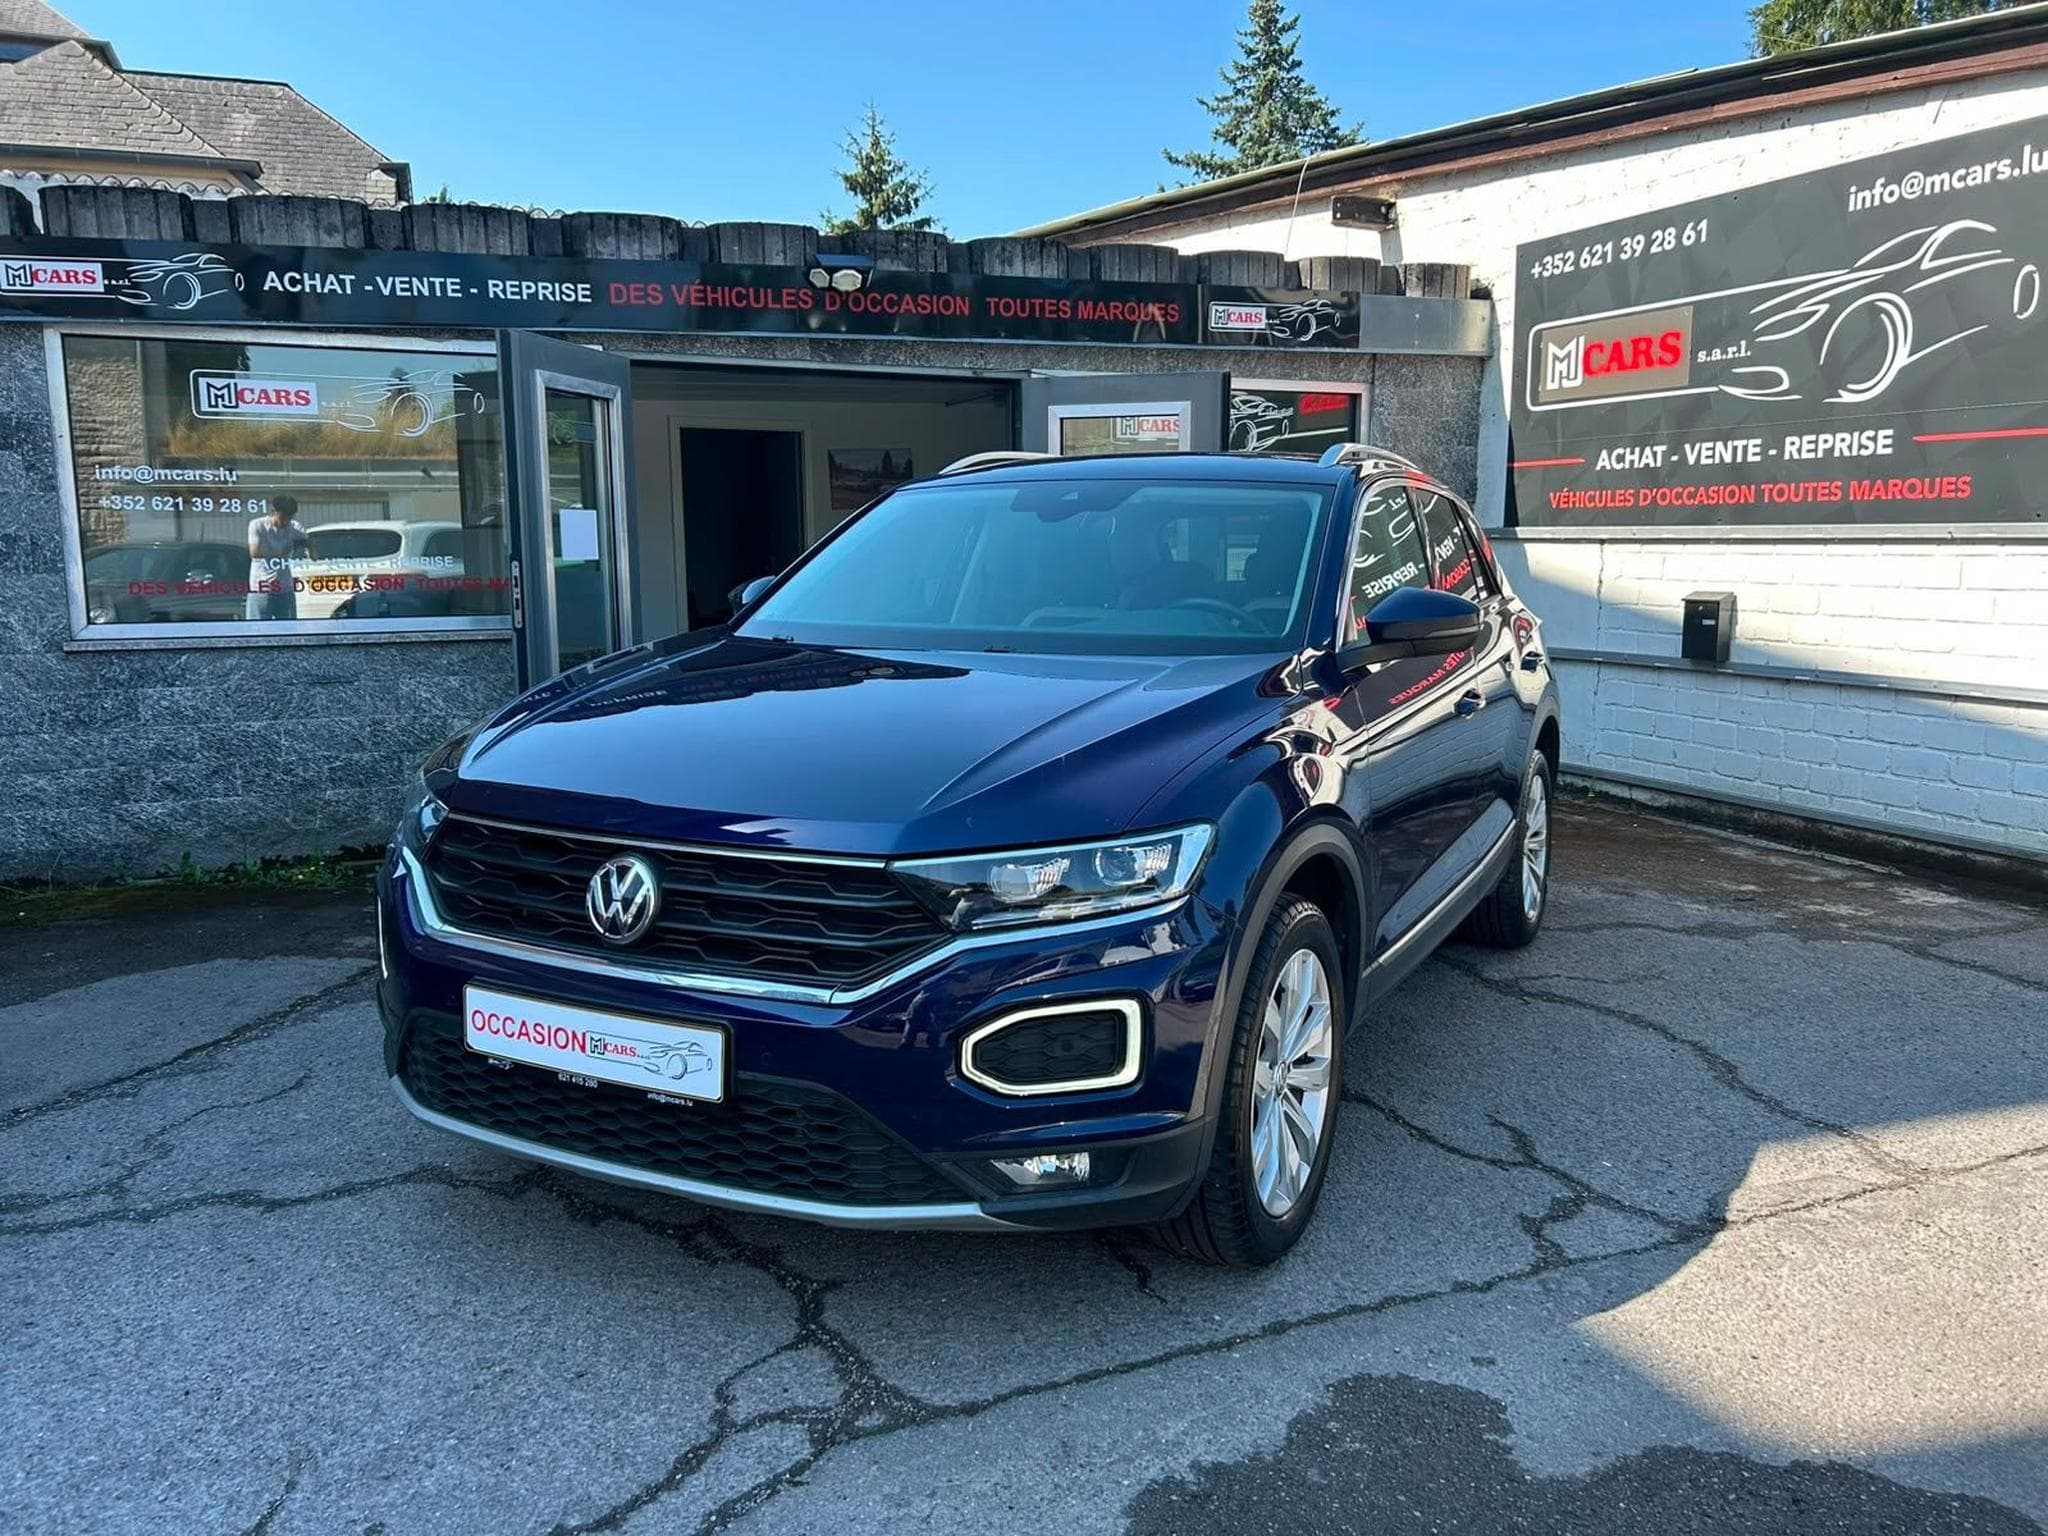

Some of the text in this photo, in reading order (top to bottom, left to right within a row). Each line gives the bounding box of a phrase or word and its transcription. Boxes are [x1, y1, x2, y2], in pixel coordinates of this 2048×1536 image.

[1848, 144, 2048, 212] info@mcars.lu
[1530, 218, 1708, 279] +352 621 39 28 61
[263, 271, 355, 295] ACHAT
[488, 279, 592, 302] REPRISE
[609, 280, 1180, 323] DES VÉHICULES D'OCCASION TOUTES MARQUES
[1697, 340, 1751, 362] s.a.r.l.
[1596, 445, 1667, 470] ACHAT
[1684, 438, 1762, 465] VENTE
[1784, 429, 1894, 460] REPRISE
[95, 465, 238, 484] info@mcars.lu
[152, 496, 184, 511] 621
[192, 497, 214, 512] 39
[219, 498, 242, 513] 28
[247, 499, 267, 513] 61
[1550, 476, 1972, 509] VÉHICULES D'OCCASION TOUTES MARQUES
[128, 581, 168, 596] DES
[471, 1009, 587, 1054] OCCASION
